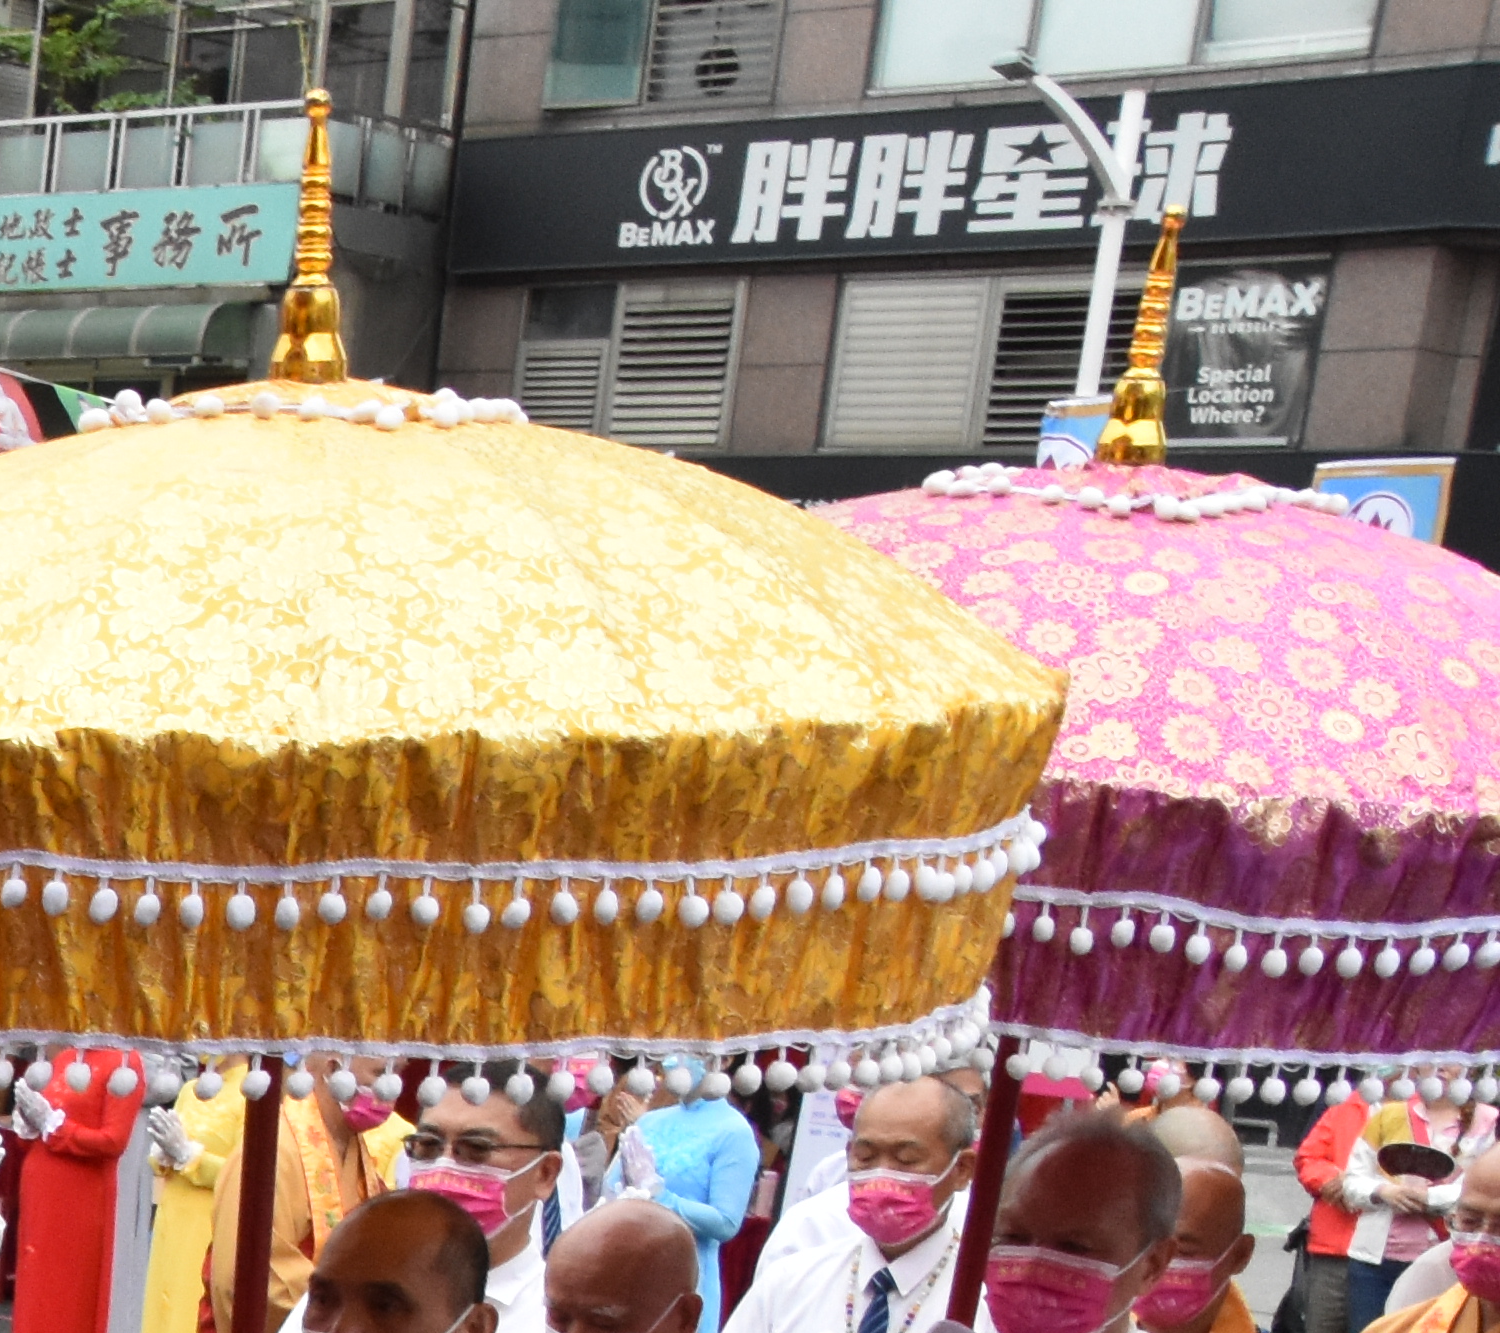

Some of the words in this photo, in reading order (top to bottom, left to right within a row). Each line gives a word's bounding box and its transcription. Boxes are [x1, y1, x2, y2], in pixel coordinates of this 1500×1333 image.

[729, 112, 1233, 244] 胖胖星球
[99, 203, 263, 277] 事務所
[1197, 364, 1272, 387] Special
[1187, 387, 1274, 404] Location
[1190, 406, 1264, 424] Where?
